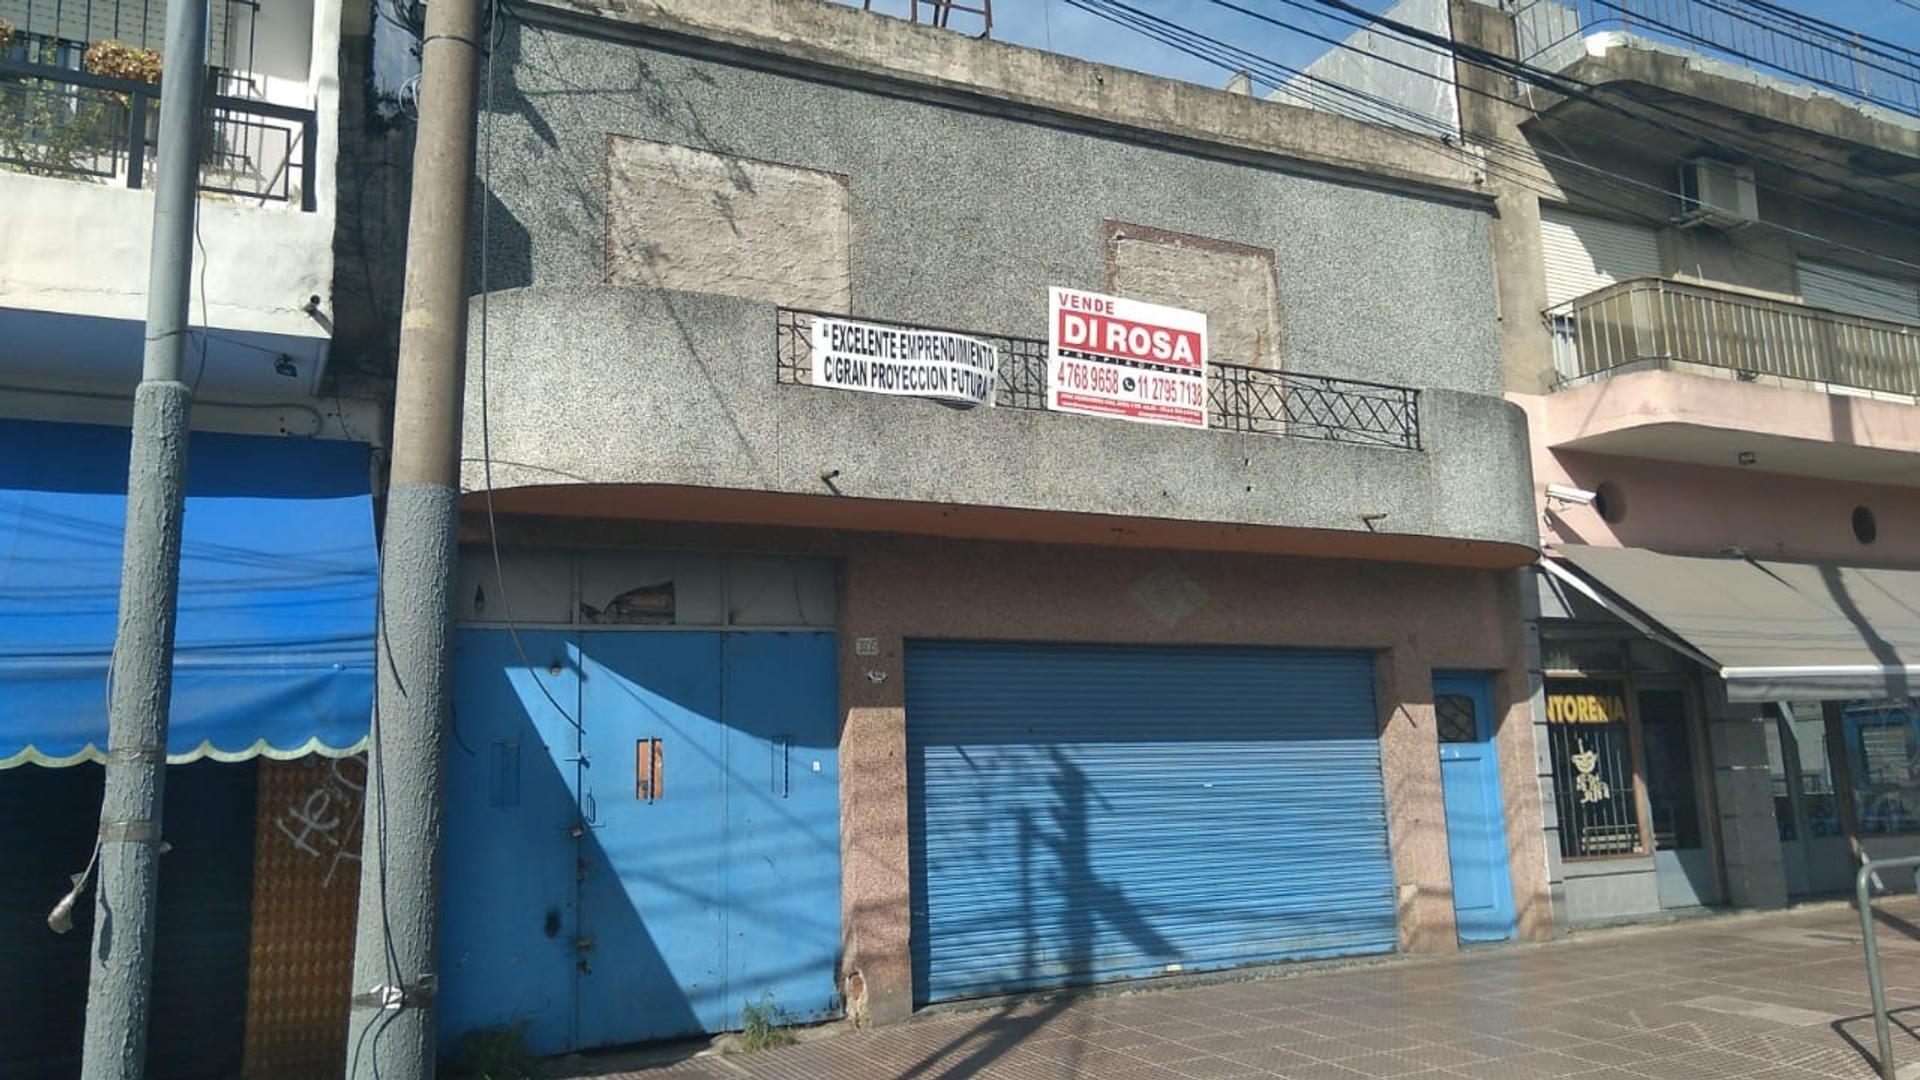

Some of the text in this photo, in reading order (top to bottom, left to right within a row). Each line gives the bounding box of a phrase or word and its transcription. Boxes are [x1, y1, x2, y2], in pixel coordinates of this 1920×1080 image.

[1059, 293, 1115, 315] VENDE
[900, 333, 995, 372] EMPRENDIMIENTO
[1064, 313, 1194, 363] DI ROSA
[871, 362, 948, 391] PROYECCION
[1091, 365, 1119, 395] 9658
[1138, 374, 1149, 399] 11
[1152, 377, 1177, 402] 2795
